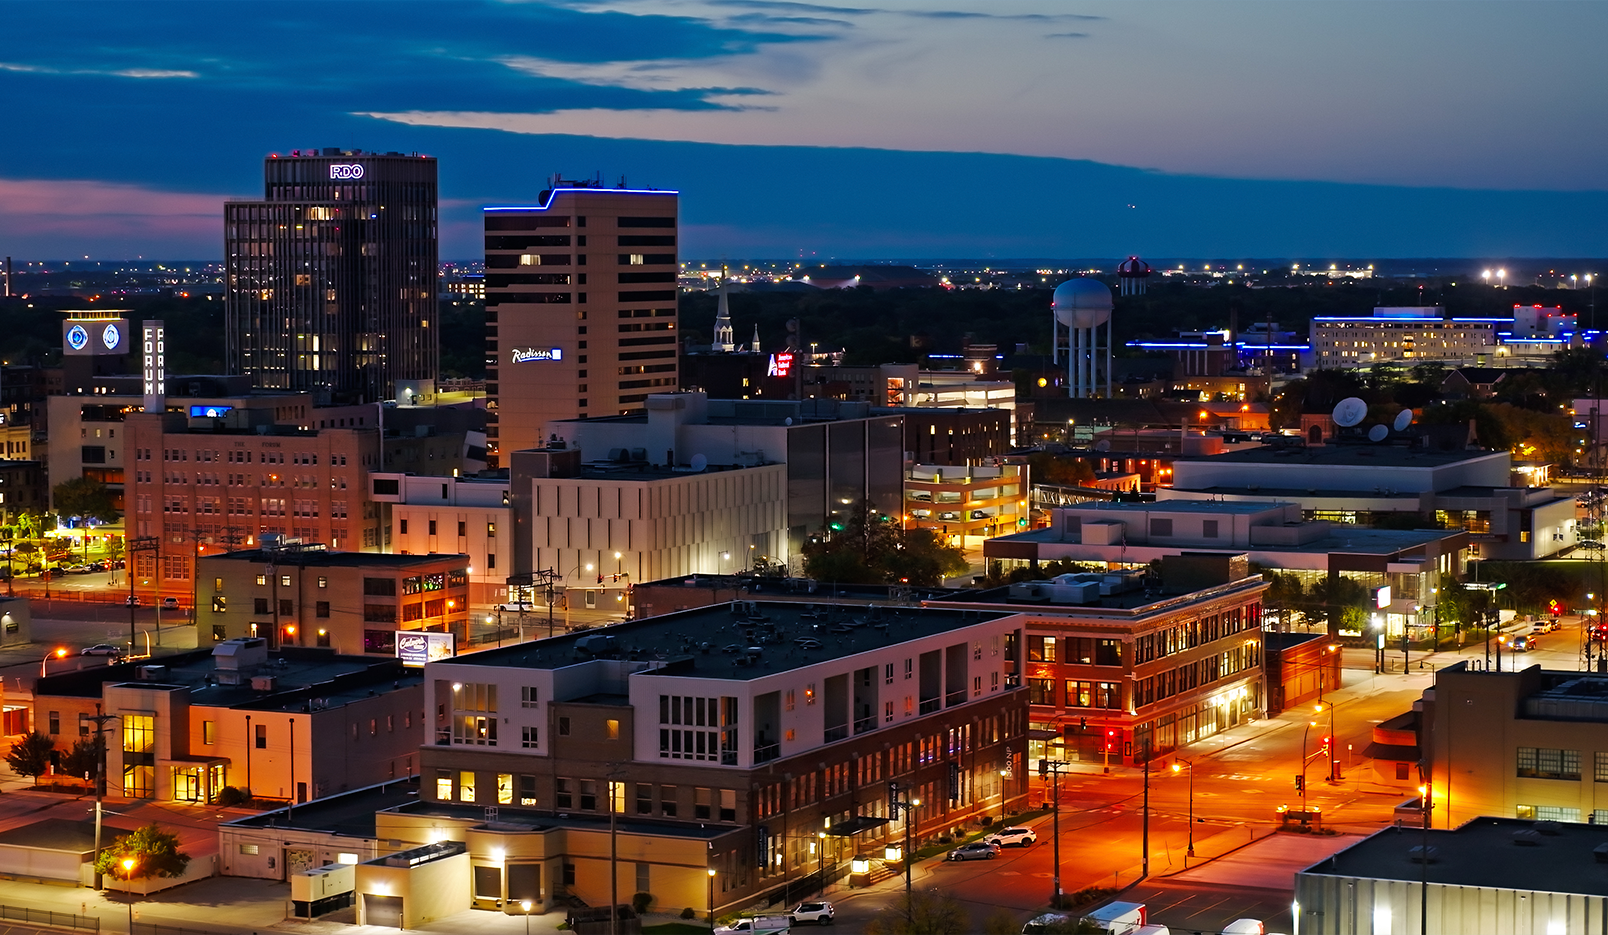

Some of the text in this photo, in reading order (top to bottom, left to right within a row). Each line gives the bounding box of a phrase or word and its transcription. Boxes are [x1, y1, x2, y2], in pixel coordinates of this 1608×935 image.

[330, 164, 364, 179] RDO
[144, 328, 153, 395] FORUM
[511, 347, 552, 364] Radisson
